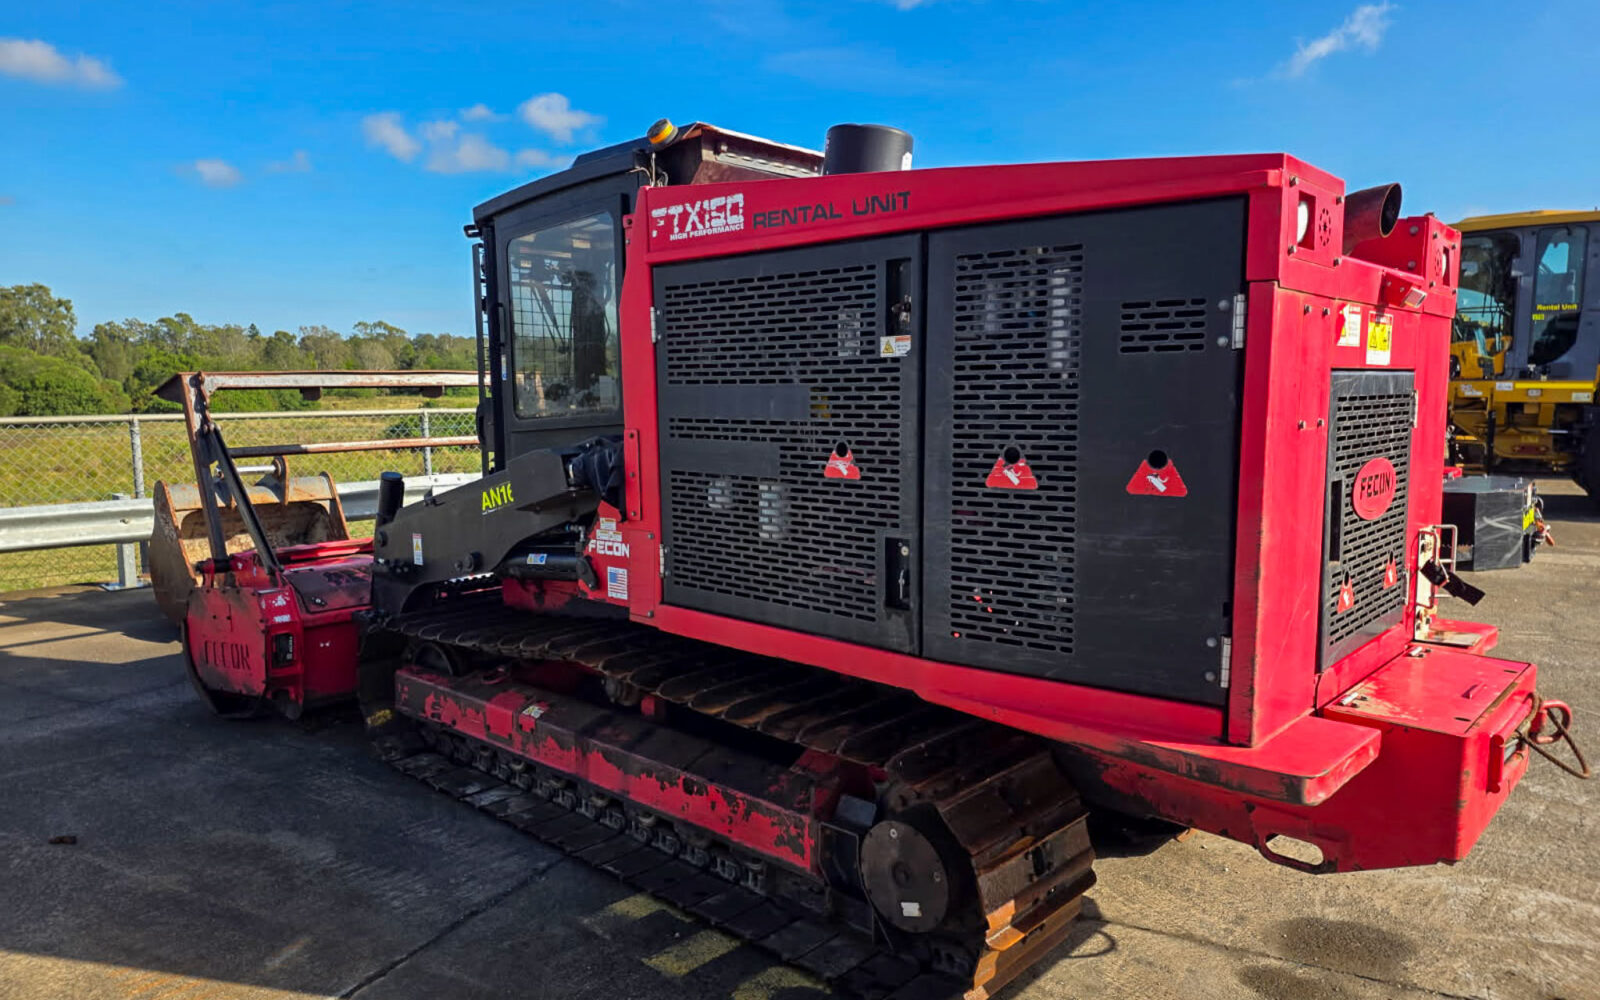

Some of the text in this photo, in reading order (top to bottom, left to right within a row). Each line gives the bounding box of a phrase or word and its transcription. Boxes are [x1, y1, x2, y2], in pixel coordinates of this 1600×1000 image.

[753, 201, 843, 229] RENTAL
[669, 222, 745, 241] HIGH PERFORMANCE
[1536, 303, 1578, 311] Rental Unit
[1360, 471, 1391, 500] FECON
[588, 539, 630, 559] FECON
